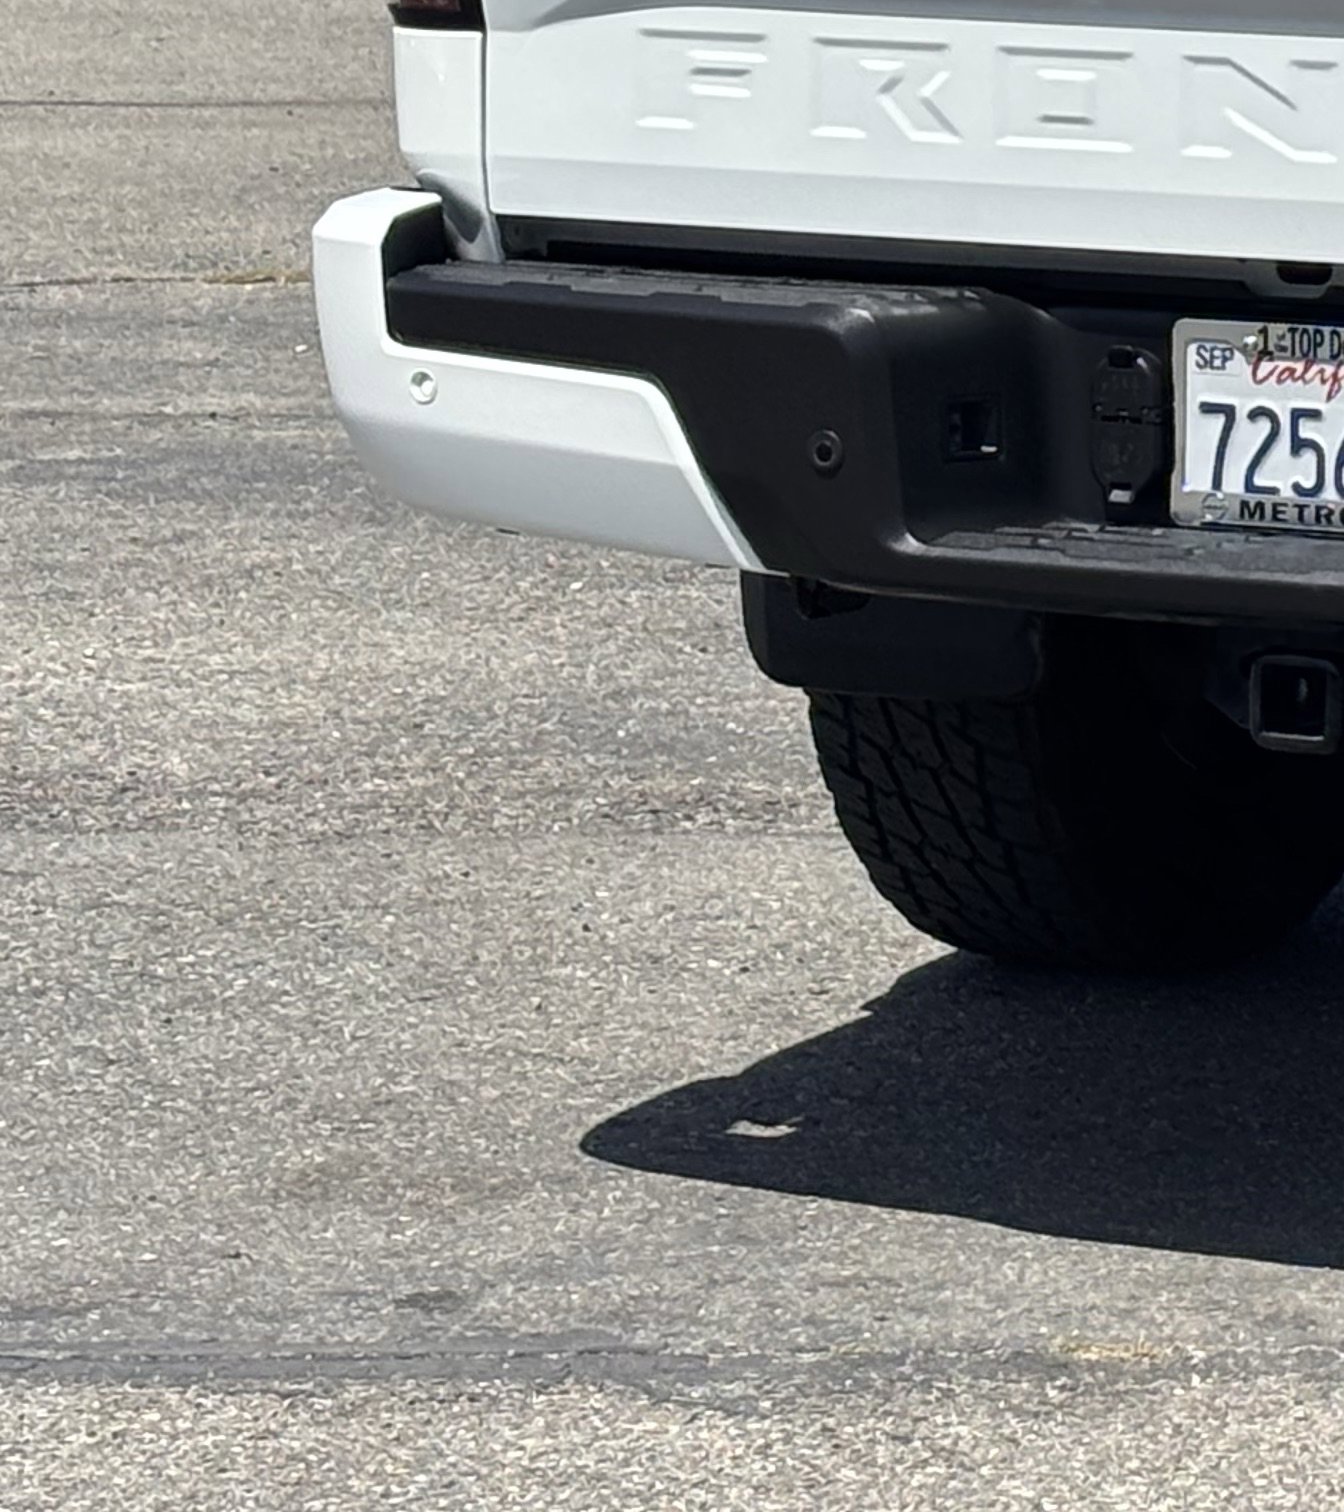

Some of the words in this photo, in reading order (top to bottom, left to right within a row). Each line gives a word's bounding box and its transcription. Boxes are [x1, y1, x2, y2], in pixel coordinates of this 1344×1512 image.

[1195, 344, 1235, 371] SEP
[1257, 325, 1274, 360] 1
[1287, 326, 1324, 359] TOP
